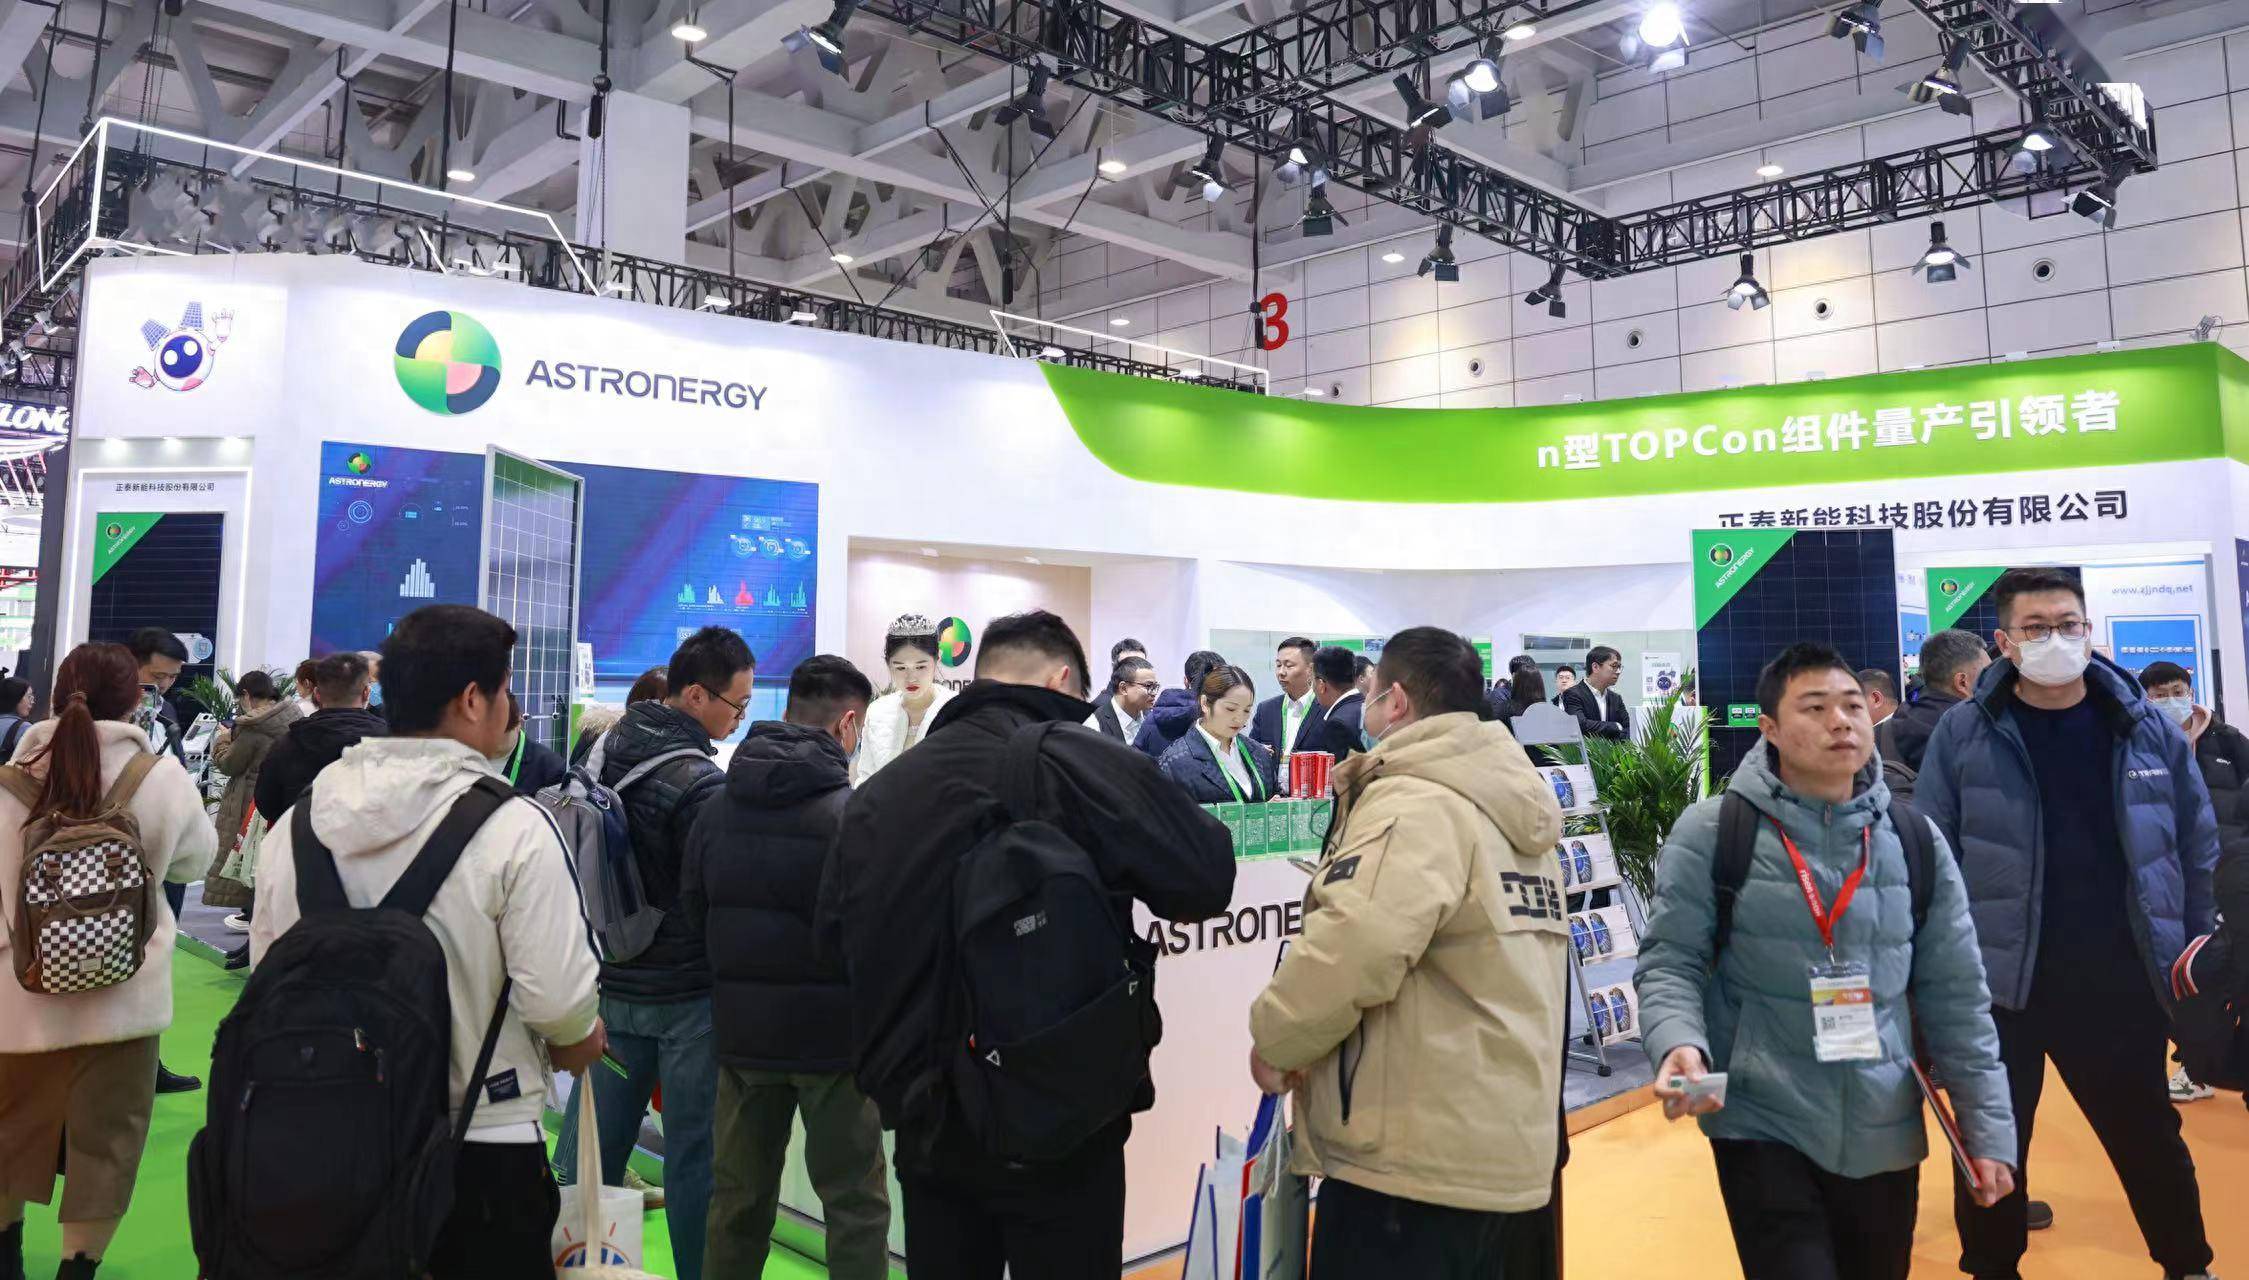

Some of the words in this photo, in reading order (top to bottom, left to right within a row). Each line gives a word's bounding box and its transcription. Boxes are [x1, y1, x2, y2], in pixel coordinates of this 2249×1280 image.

[1260, 293, 1289, 350] 3
[525, 360, 768, 411] ASTRONERGY
[1537, 390, 2120, 470] n型TOPCon组件量产引领者
[329, 477, 389, 488] ASTRONERGY
[1716, 546, 1755, 589] ASTRONERGY
